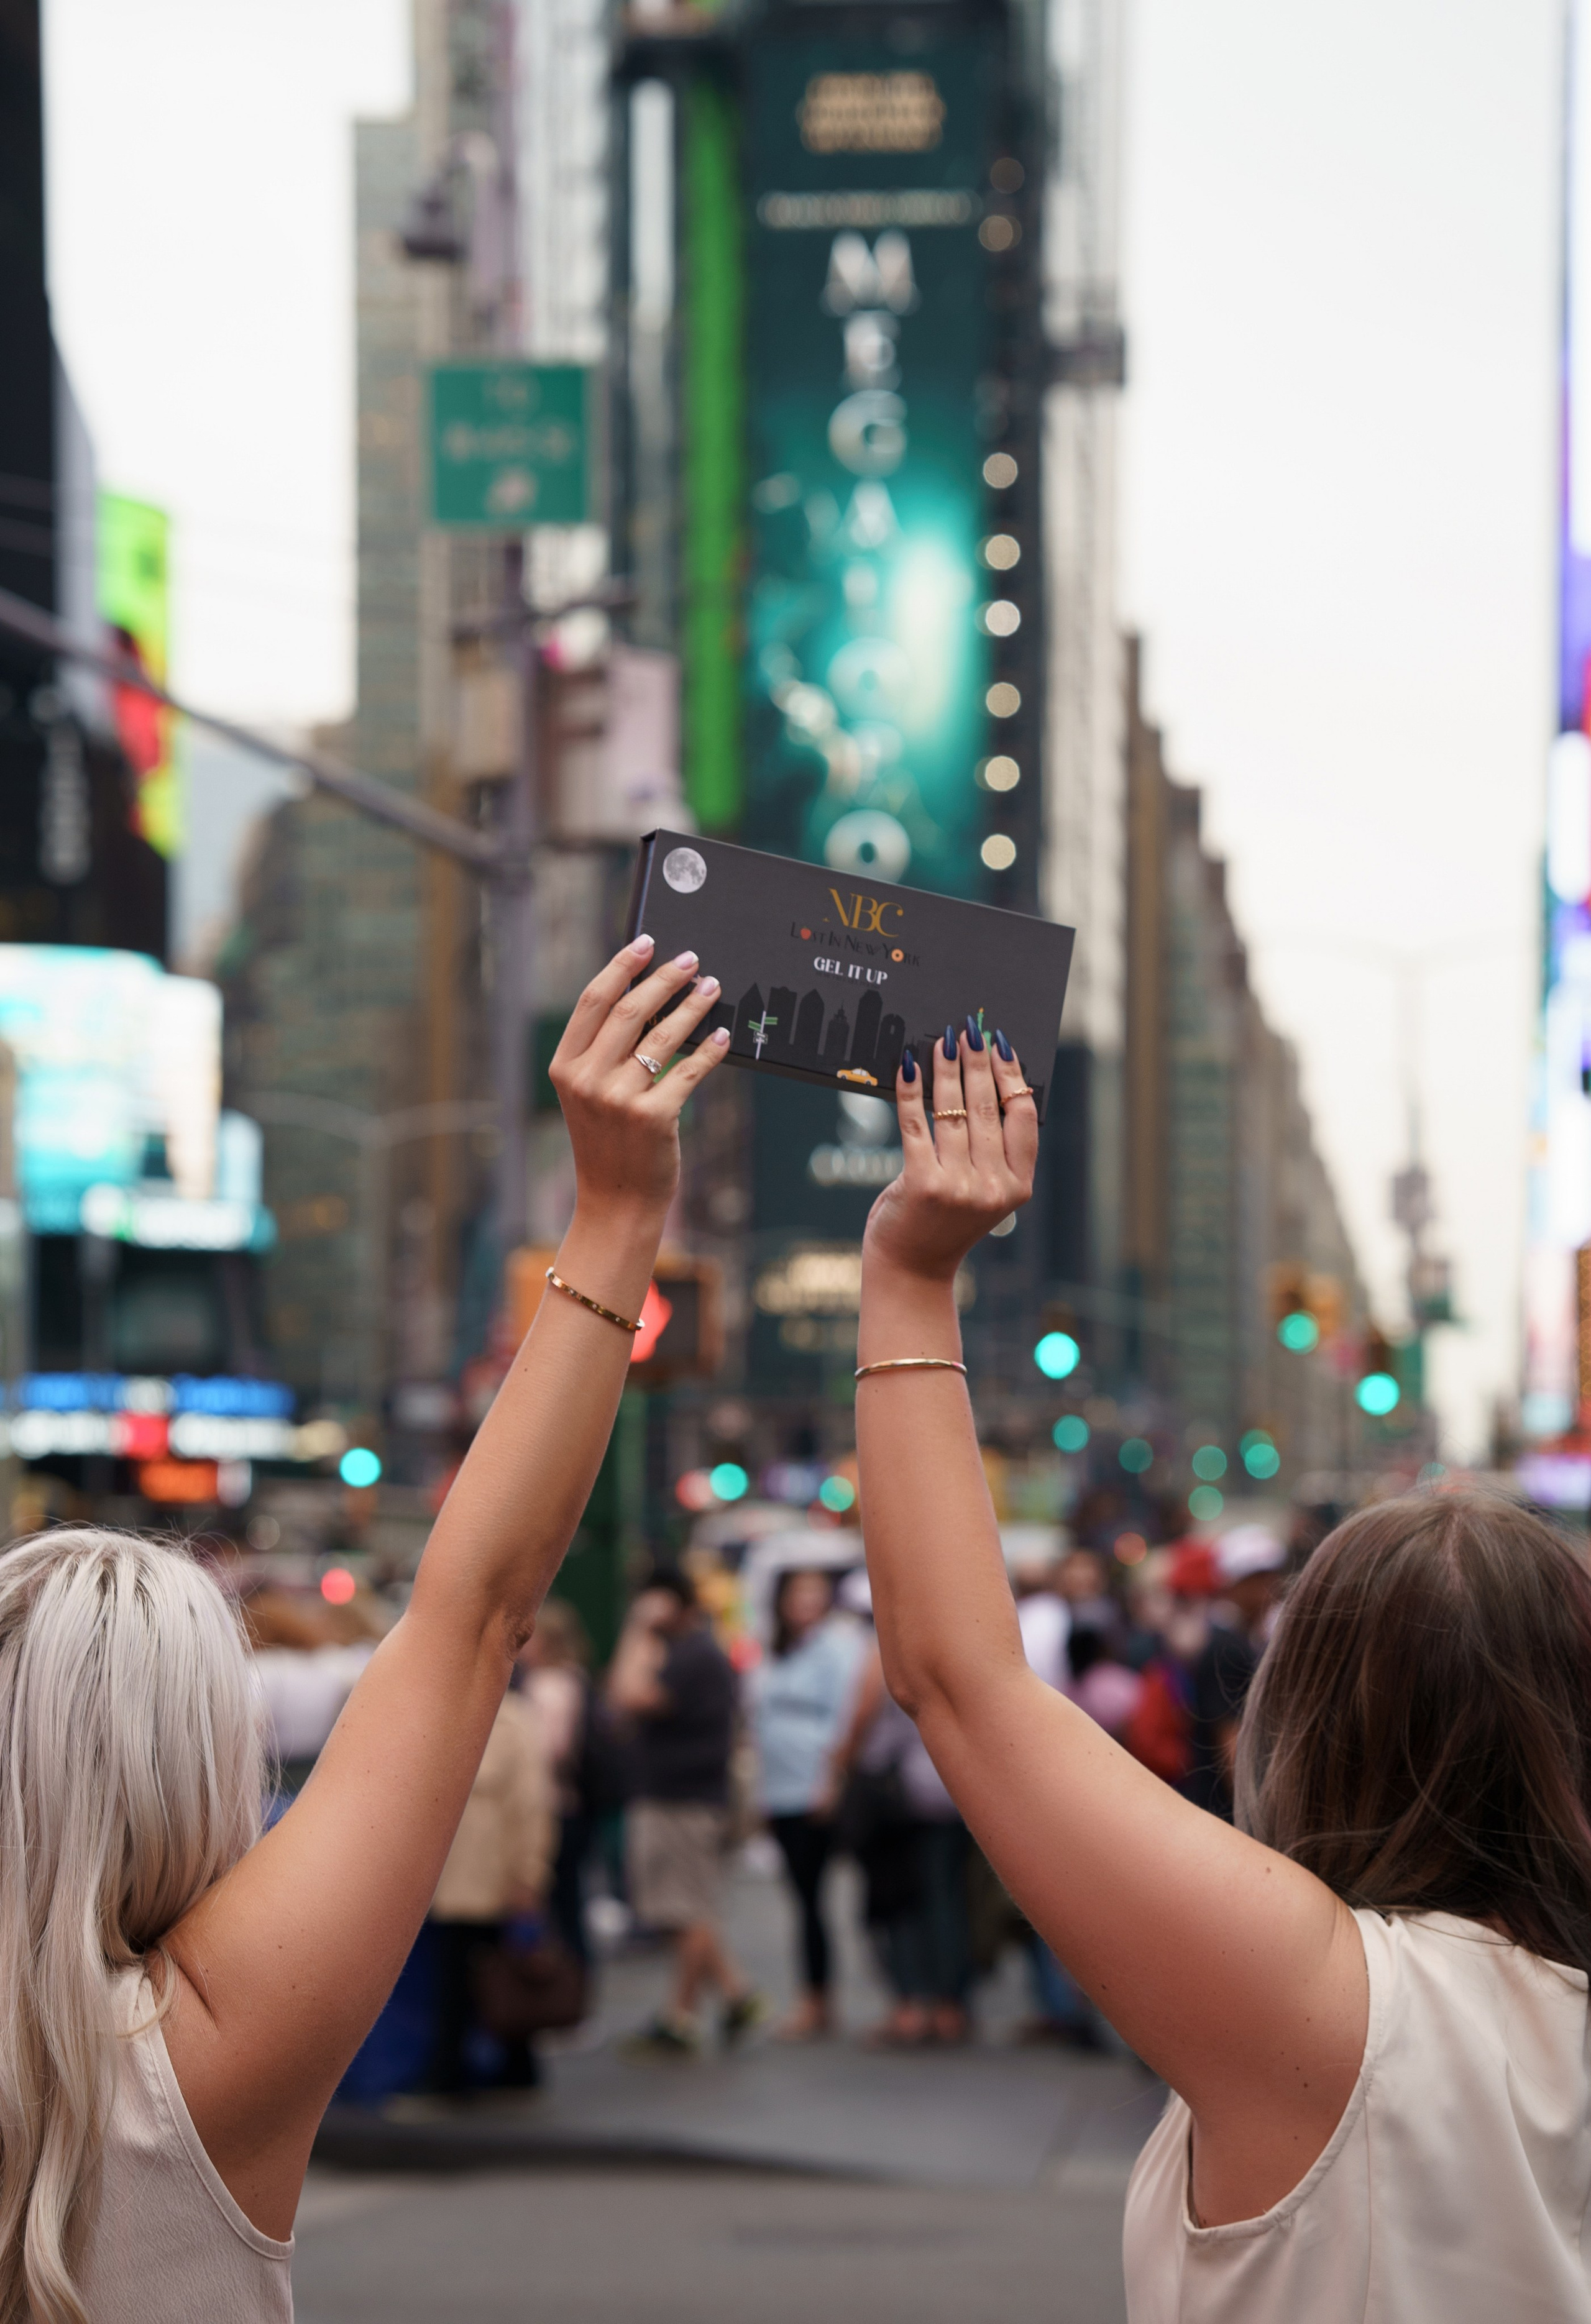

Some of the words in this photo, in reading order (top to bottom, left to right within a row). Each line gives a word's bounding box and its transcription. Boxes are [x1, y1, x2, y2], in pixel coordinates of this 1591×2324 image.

[813, 956, 844, 976] GEL
[847, 964, 864, 979] IT
[865, 968, 888, 985] UP
